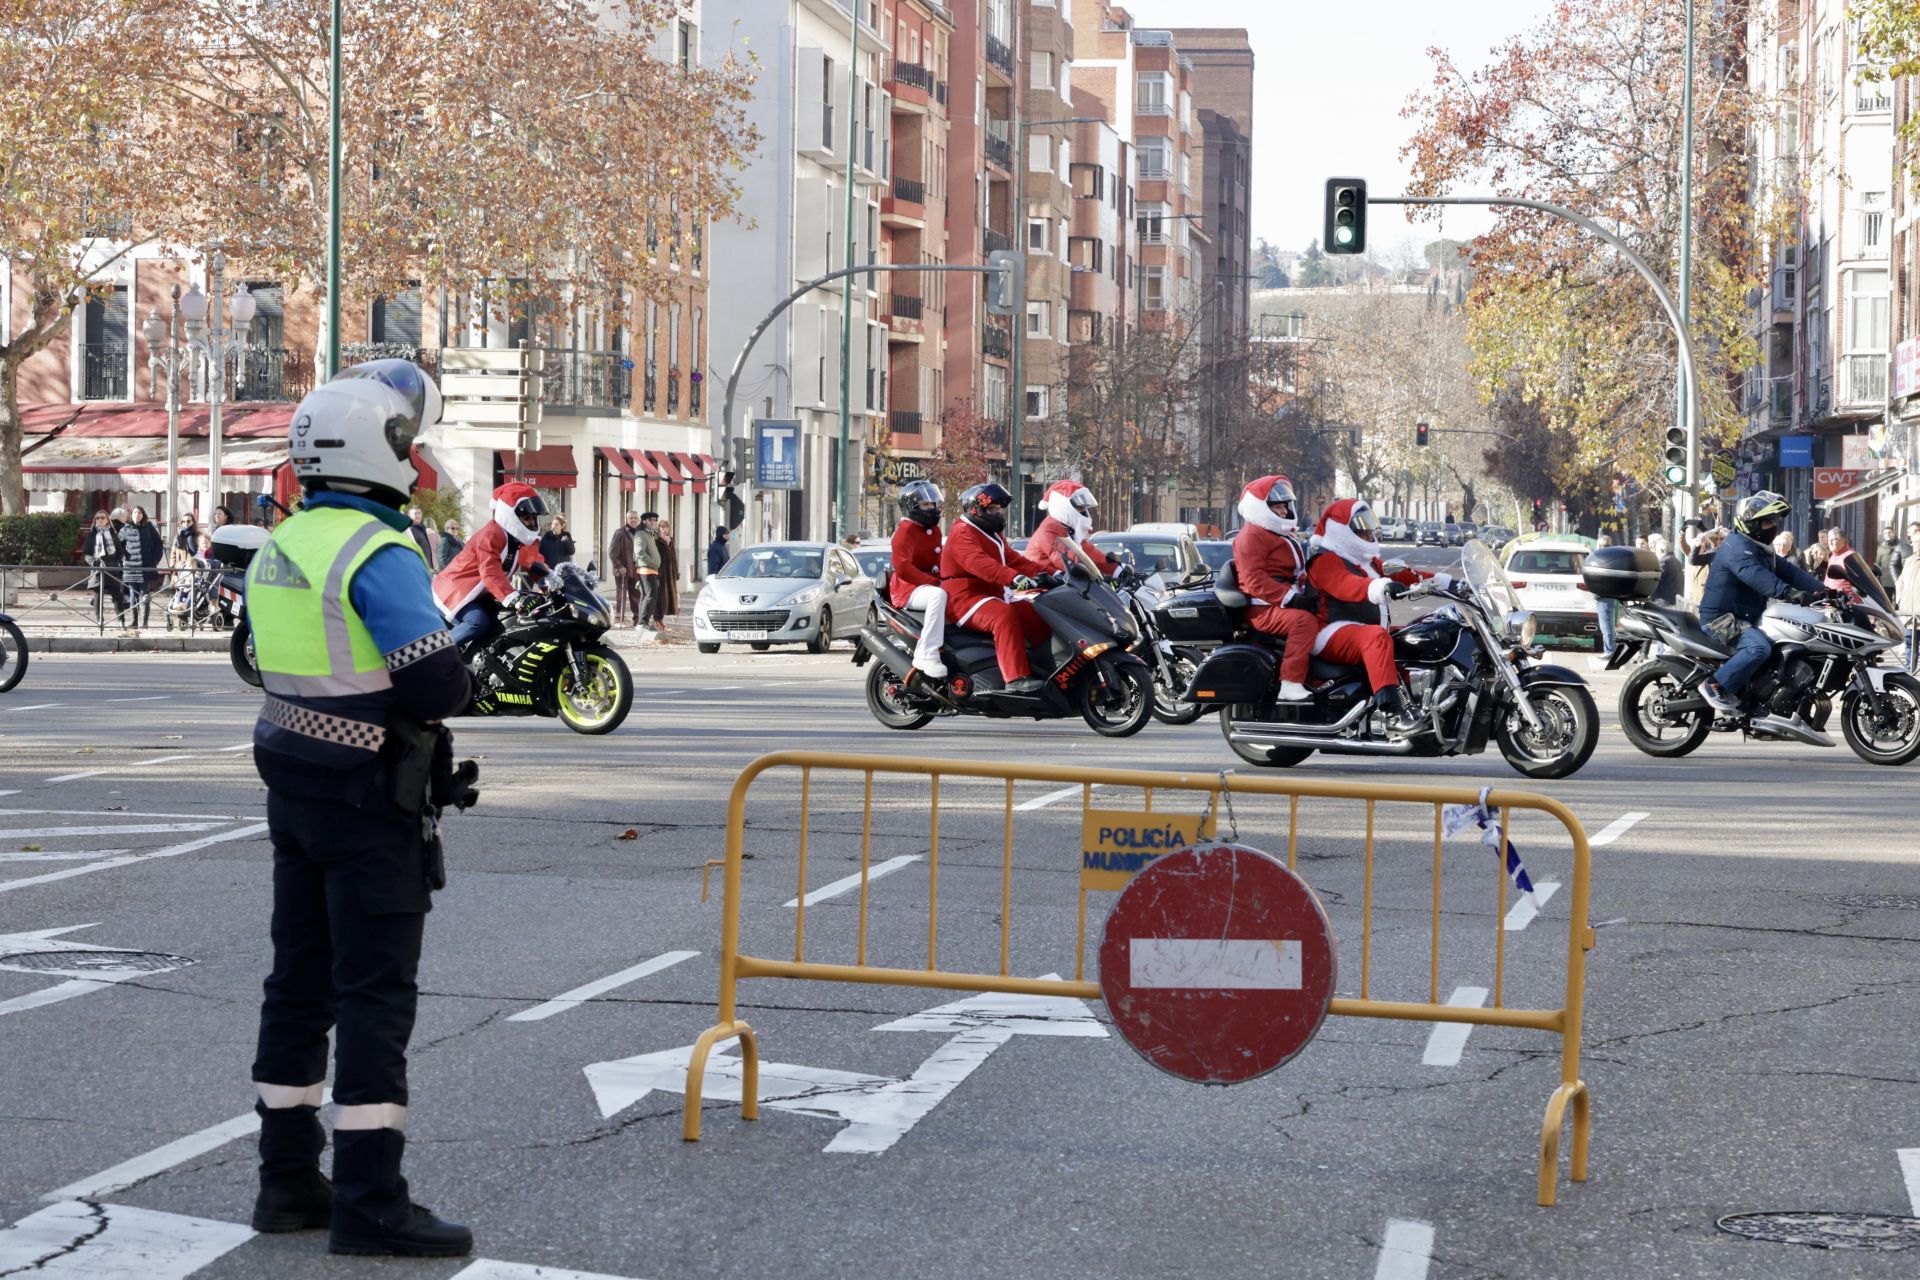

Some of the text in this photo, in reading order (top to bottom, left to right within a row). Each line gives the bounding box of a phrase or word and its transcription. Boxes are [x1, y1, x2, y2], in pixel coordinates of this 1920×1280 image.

[762, 428, 795, 463] T
[495, 691, 533, 705] YAMAHA
[1098, 823, 1186, 849] POLICÍA
